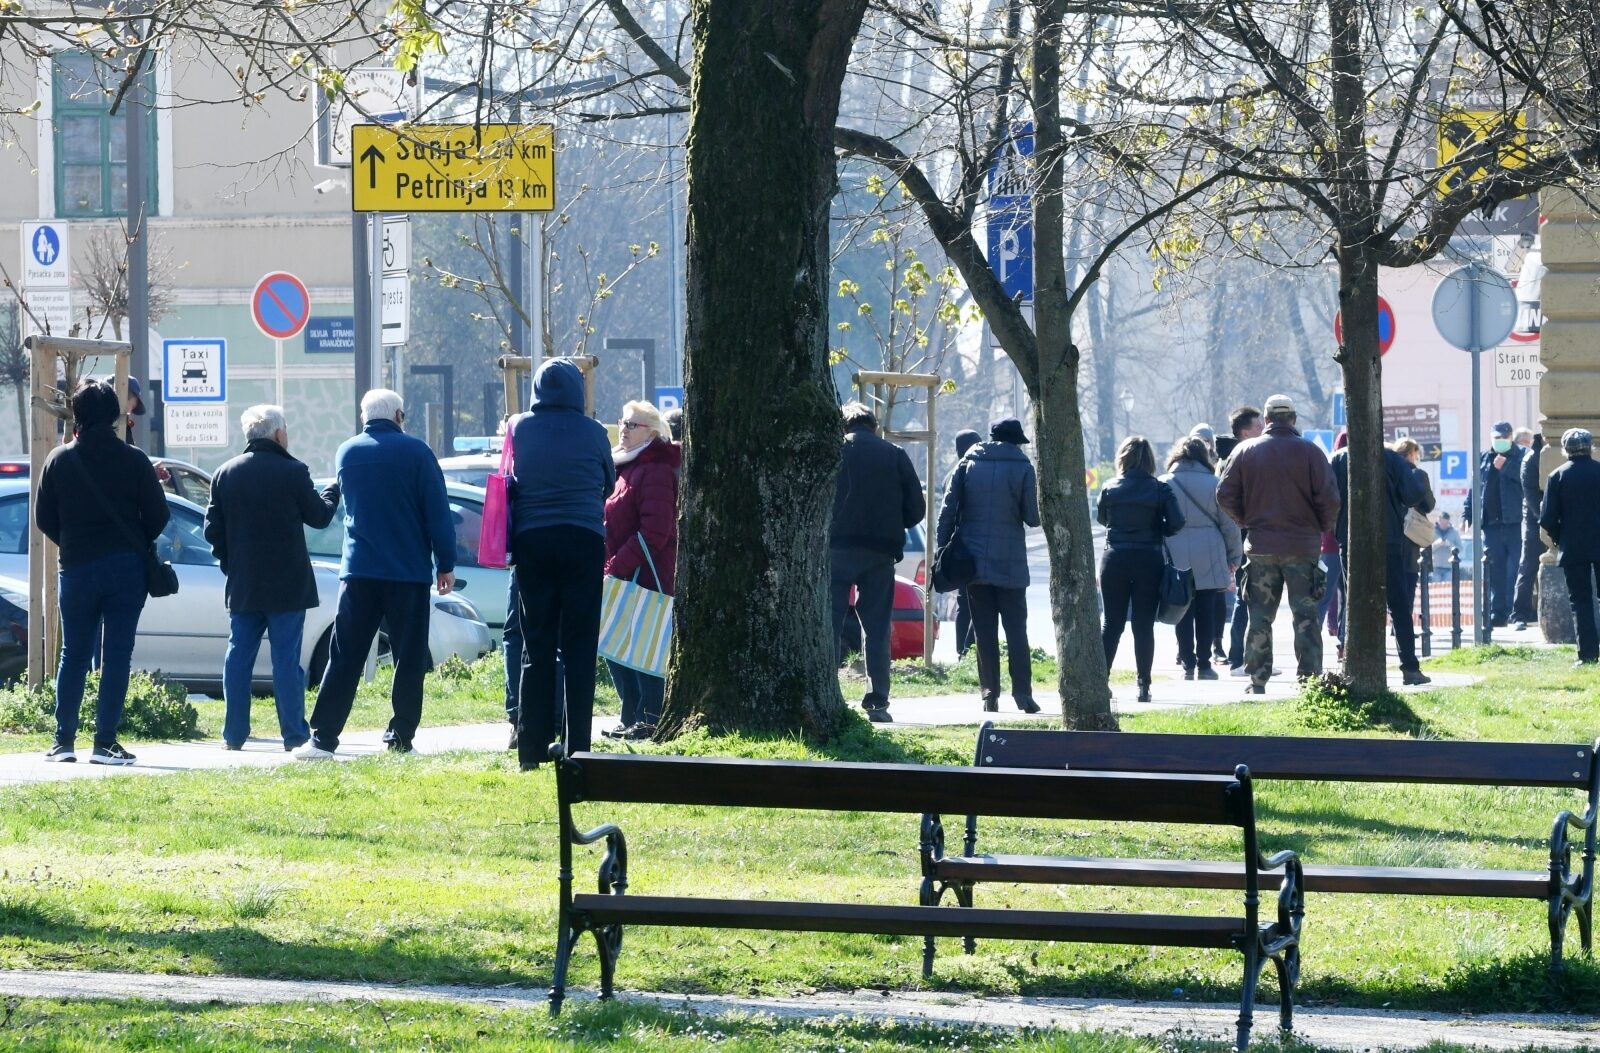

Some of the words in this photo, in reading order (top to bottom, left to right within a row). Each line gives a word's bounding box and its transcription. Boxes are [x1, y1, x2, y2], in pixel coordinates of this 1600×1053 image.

[396, 134, 466, 166] Sunja
[522, 140, 546, 159] km
[396, 173, 487, 205] Petrinja
[497, 180, 513, 198] 13
[523, 179, 546, 198] km
[1000, 230, 1019, 283] P
[181, 348, 209, 359] Taxi
[1498, 353, 1525, 364] Stari
[1510, 369, 1531, 380] 200
[659, 396, 678, 414] P
[176, 434, 196, 442] Grada
[1447, 455, 1460, 475] P
